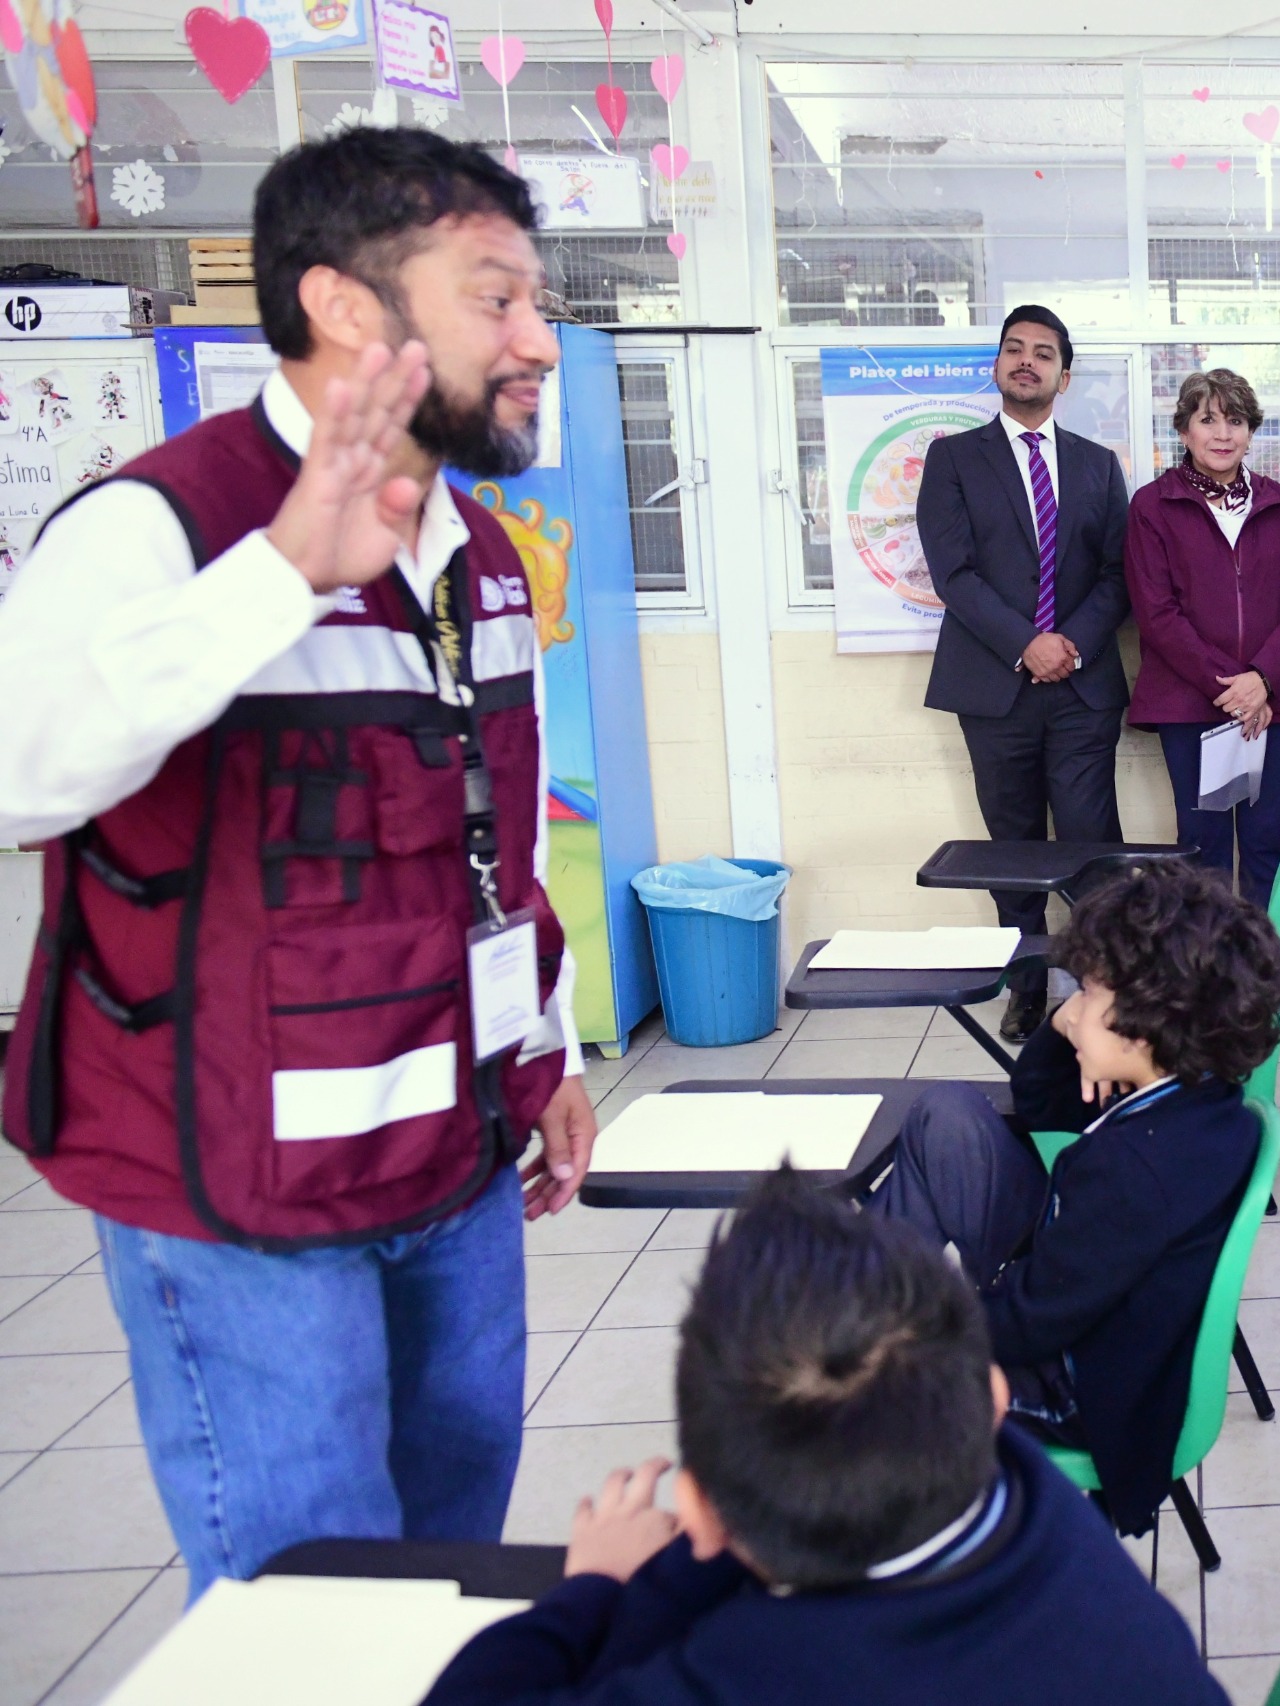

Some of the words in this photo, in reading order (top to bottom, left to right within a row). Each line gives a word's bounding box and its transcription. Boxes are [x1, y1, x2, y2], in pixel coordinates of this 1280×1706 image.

[11, 296, 36, 331] hp
[849, 366, 897, 379] Plato
[901, 364, 929, 378] del
[934, 363, 974, 377] bien
[883, 412, 894, 422] De
[894, 399, 938, 414] temporada
[946, 400, 991, 415] producción
[910, 416, 948, 427] VERDURAS
[902, 603, 922, 615] Evita
